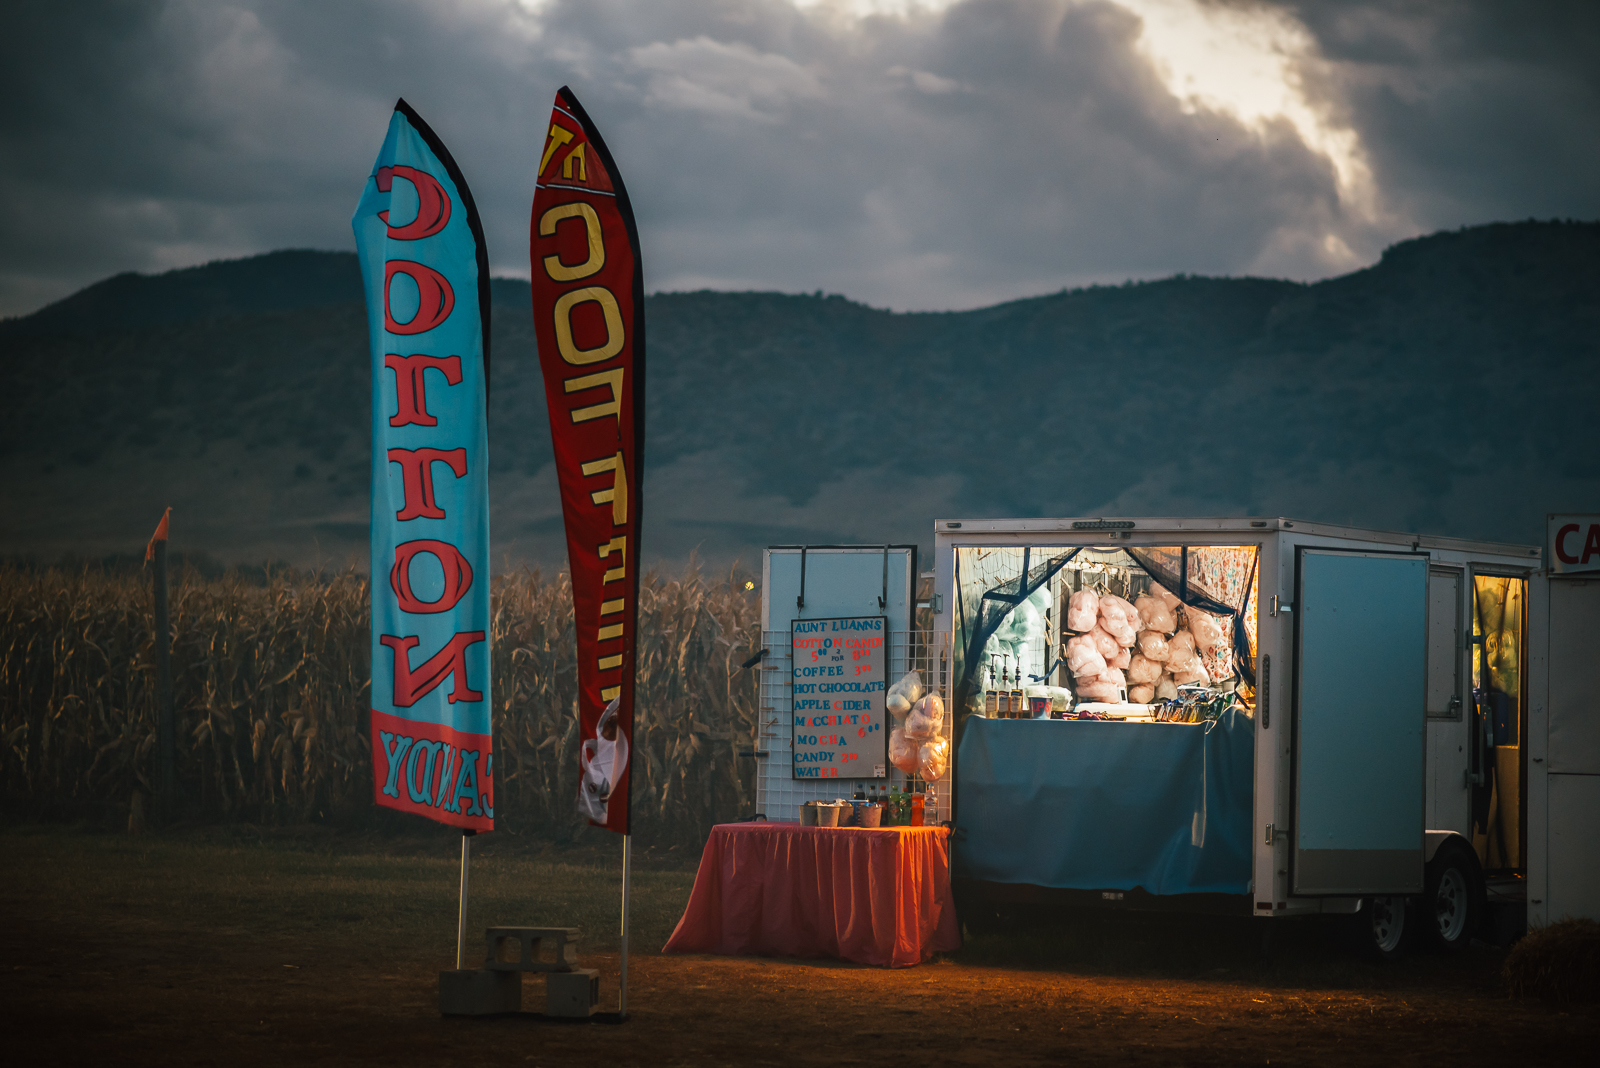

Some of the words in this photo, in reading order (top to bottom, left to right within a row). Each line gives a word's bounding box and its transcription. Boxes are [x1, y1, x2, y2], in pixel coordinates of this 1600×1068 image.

[794, 621, 828, 633] AUNT
[831, 619, 882, 632] LUANNS
[792, 637, 842, 649] COTTON
[845, 636, 885, 649] CANDY
[793, 665, 844, 678] COFFEE
[793, 683, 817, 694] HOT
[818, 680, 885, 693] CHOCOLATE
[794, 699, 831, 711] APPLE
[833, 699, 871, 711] CIDER
[795, 713, 870, 727] MACCHIATO
[797, 734, 847, 746] MOCHA
[794, 751, 835, 763] CANDY
[795, 767, 838, 778] WATER
